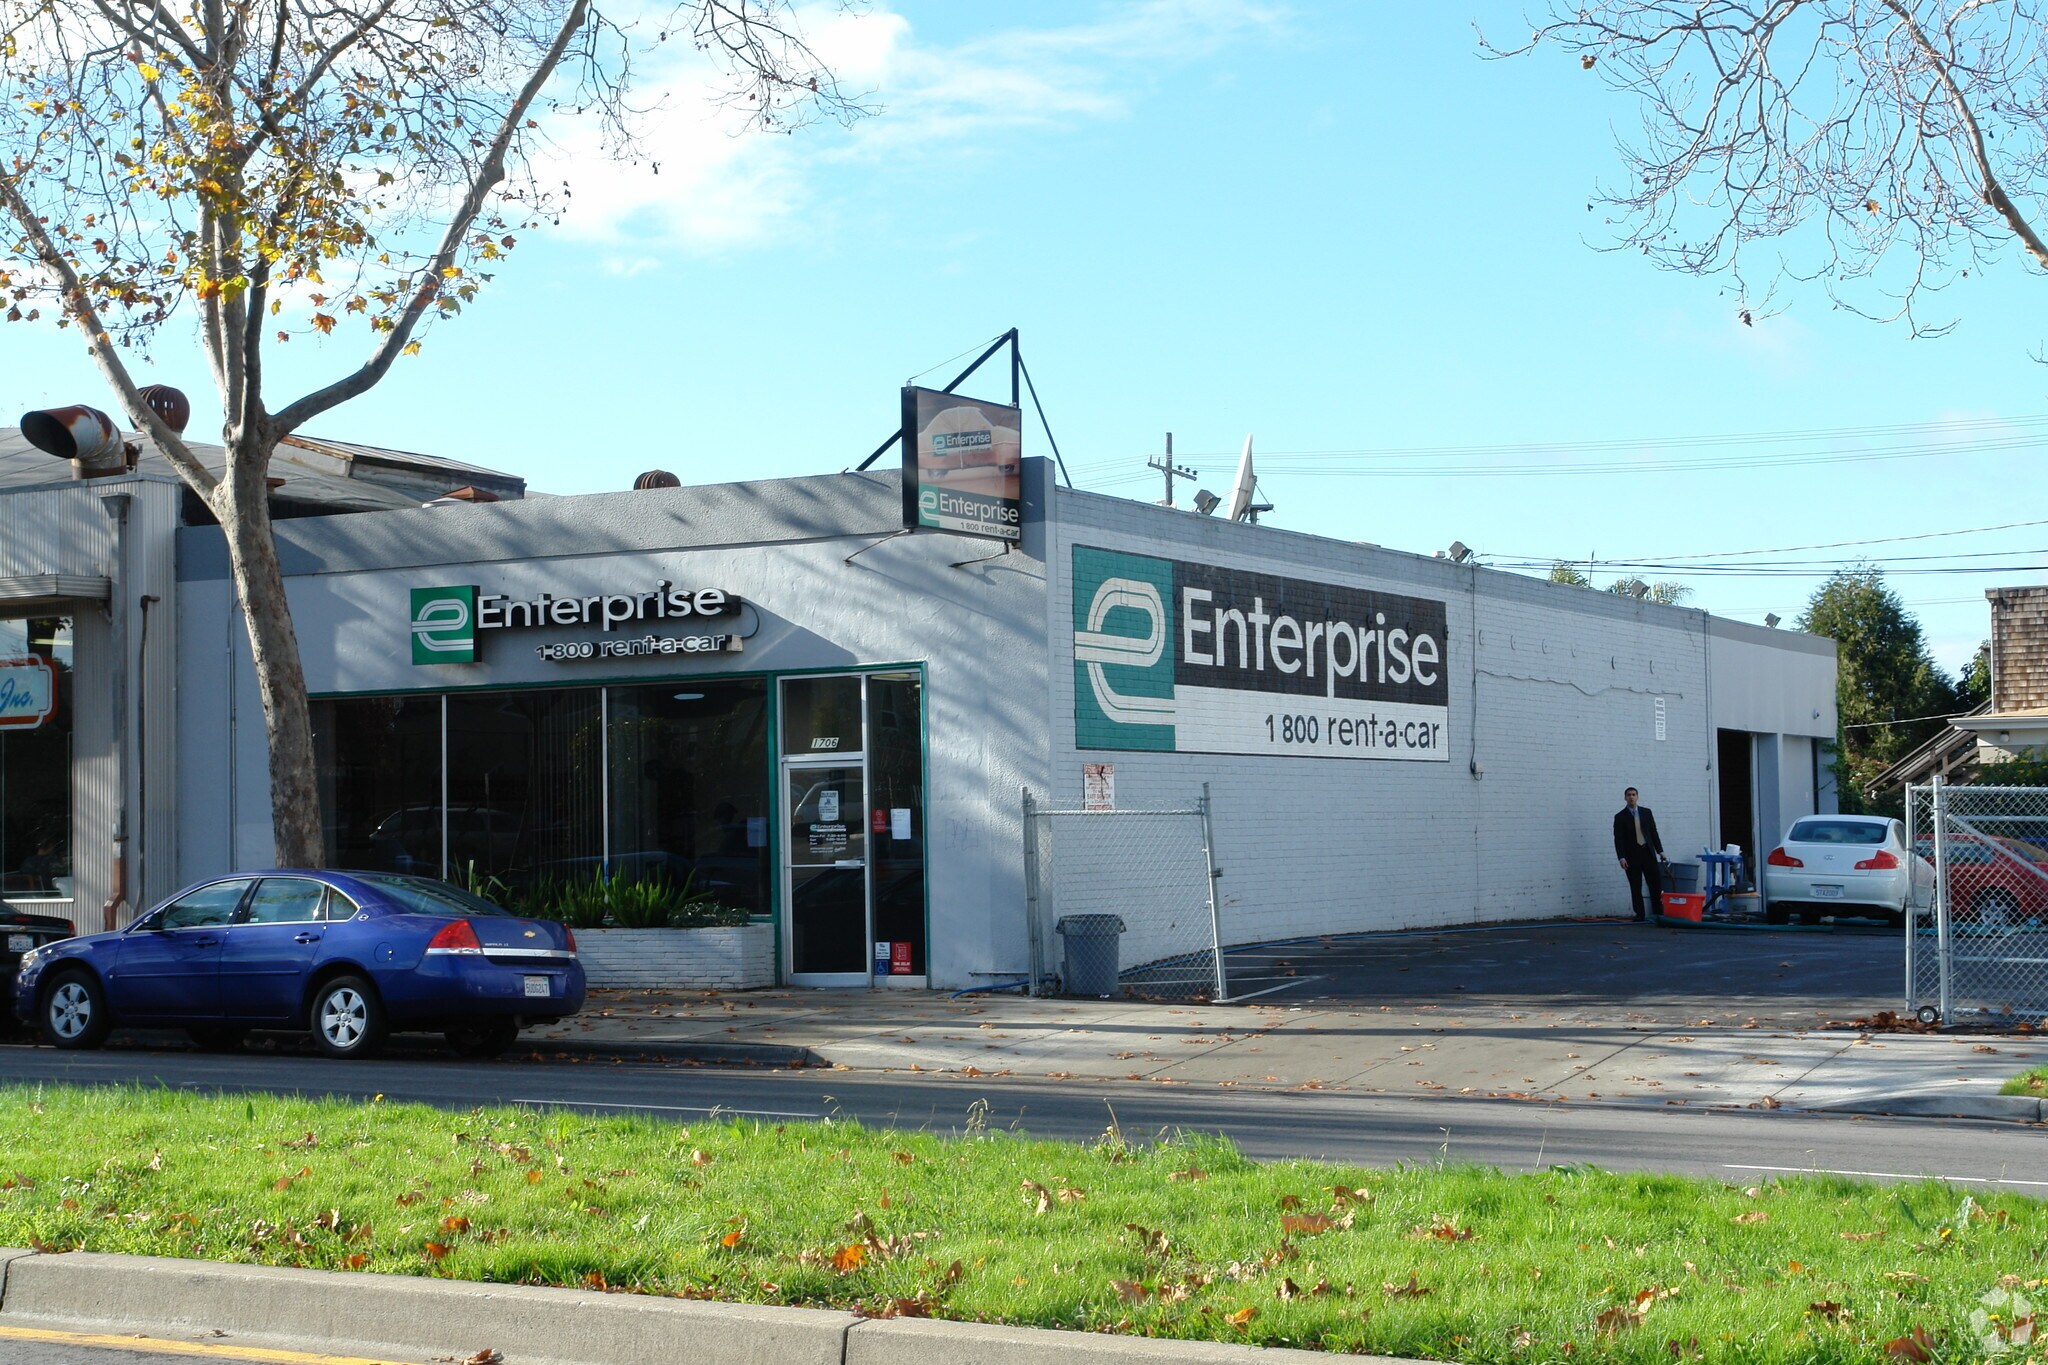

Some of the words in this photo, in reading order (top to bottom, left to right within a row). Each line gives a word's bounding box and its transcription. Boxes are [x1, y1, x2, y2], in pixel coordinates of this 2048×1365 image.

[947, 432, 990, 446] Enterprise
[939, 492, 1019, 523] Enterprise
[965, 522, 979, 531] 800
[477, 579, 726, 632] Enterprise
[599, 635, 726, 657] rent-a-car
[1183, 585, 1439, 699] Enterprise
[1265, 714, 1275, 742] 1
[1282, 714, 1319, 743] 800
[814, 739, 837, 747] 1706
